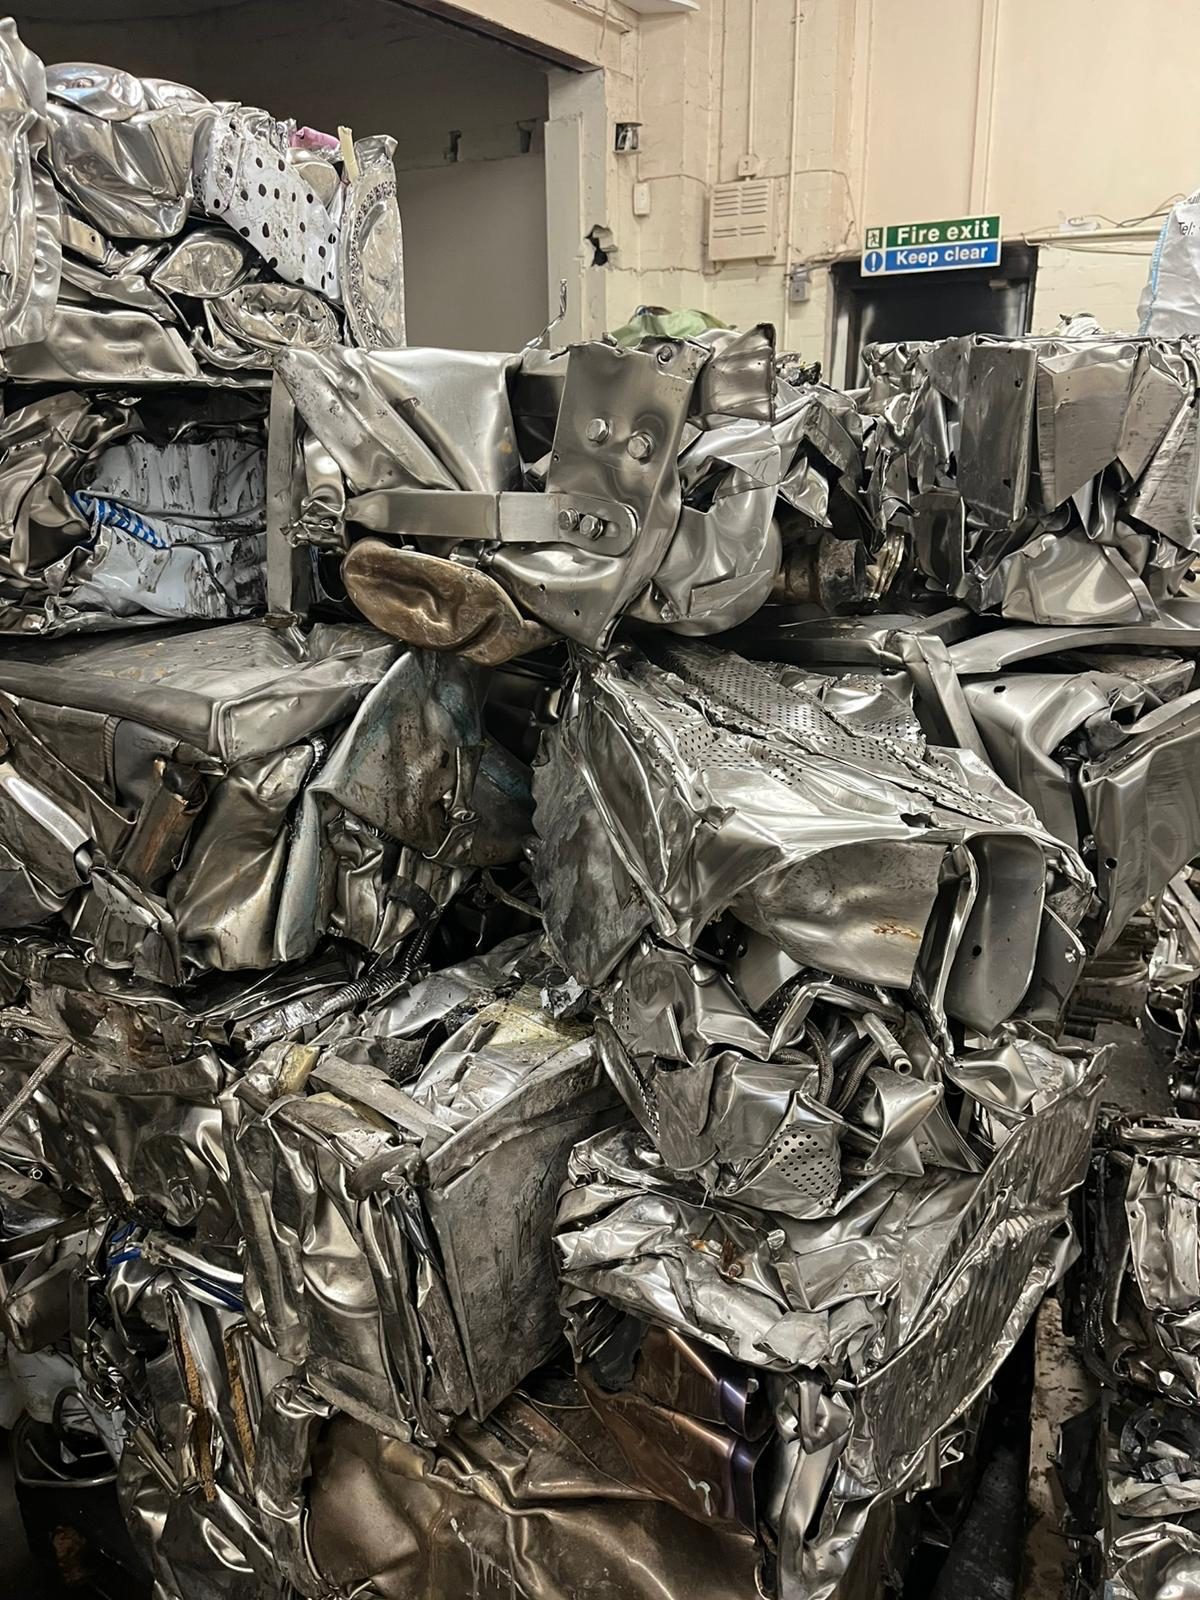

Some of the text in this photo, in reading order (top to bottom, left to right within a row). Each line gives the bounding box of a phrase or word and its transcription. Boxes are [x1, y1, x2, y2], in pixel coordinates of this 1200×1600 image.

[897, 220, 989, 245] Fire exit
[1178, 222, 1196, 236] Tel:
[897, 246, 988, 266] Keep clear
